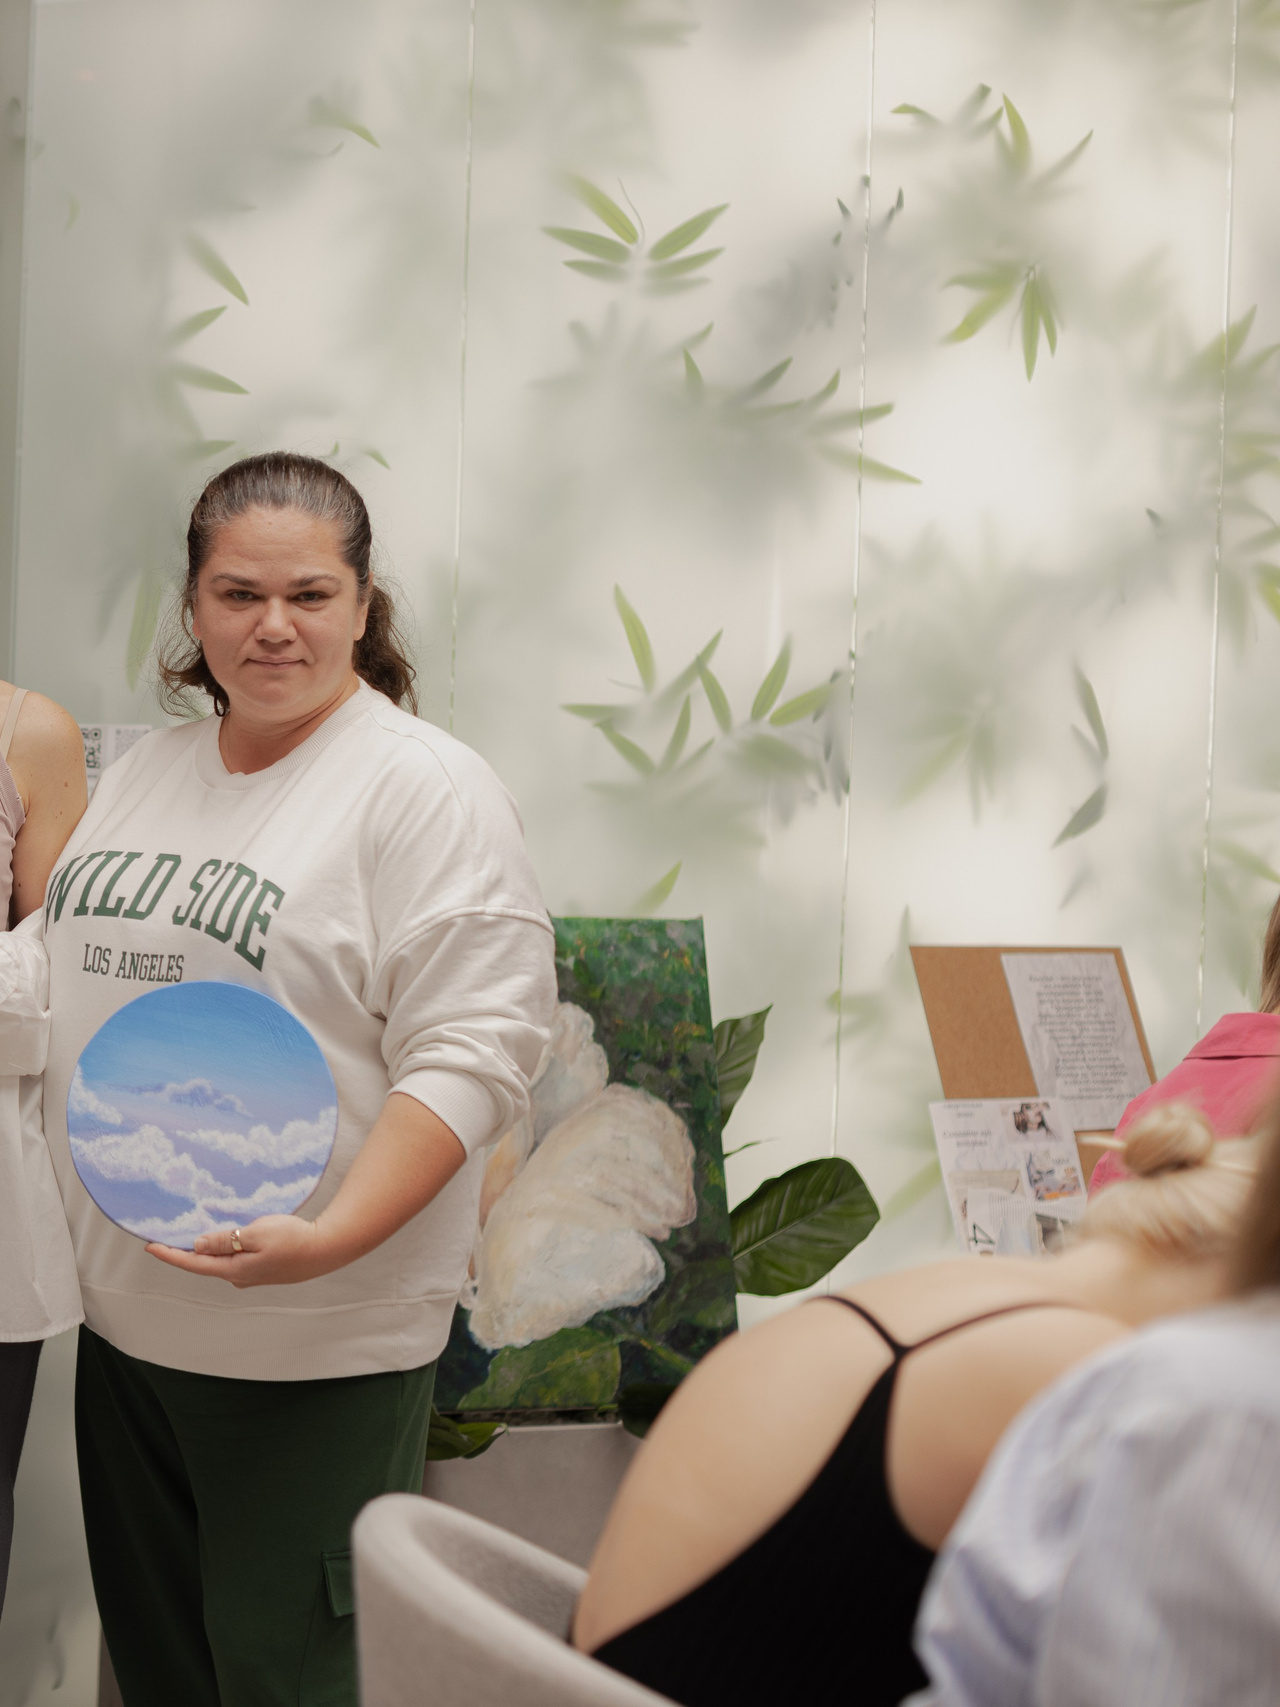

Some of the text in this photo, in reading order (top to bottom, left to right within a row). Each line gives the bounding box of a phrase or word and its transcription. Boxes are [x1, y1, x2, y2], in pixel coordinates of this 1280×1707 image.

[45, 850, 286, 972] WILD SIDE
[82, 943, 185, 983] LOS ANGELES
